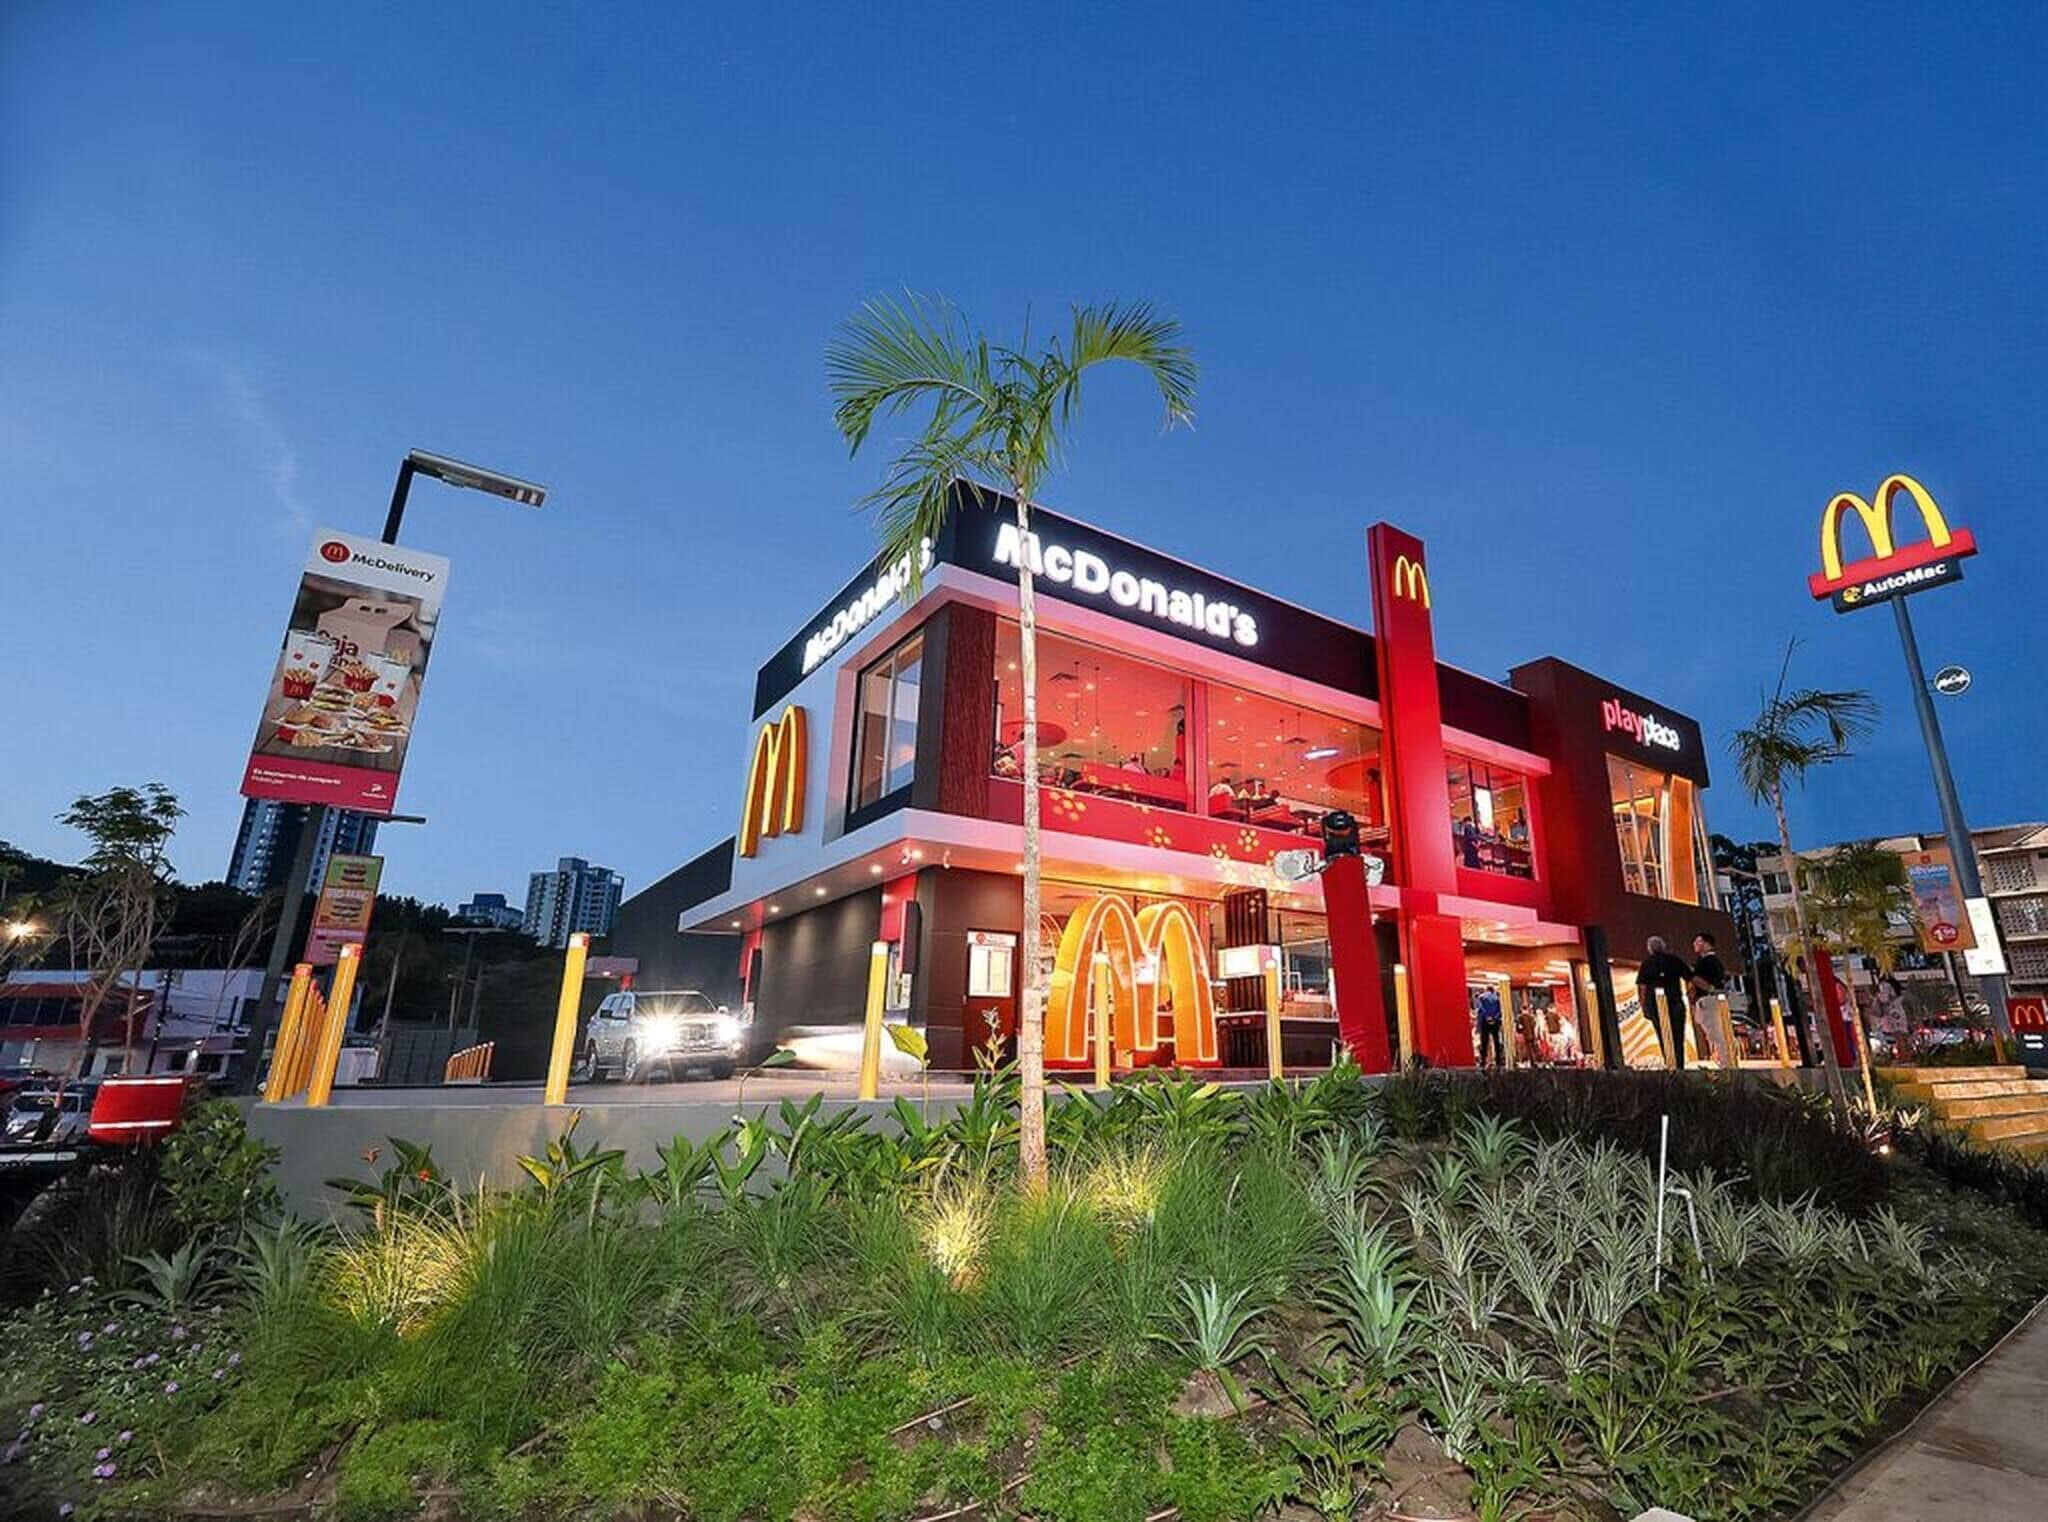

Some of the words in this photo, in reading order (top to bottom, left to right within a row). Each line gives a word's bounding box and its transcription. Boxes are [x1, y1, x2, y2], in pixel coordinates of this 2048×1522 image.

[352, 553, 436, 583] McDelivery
[801, 536, 932, 675] McDonalds
[992, 523, 1259, 647] McDonald's
[1863, 563, 1948, 597] AutoMac
